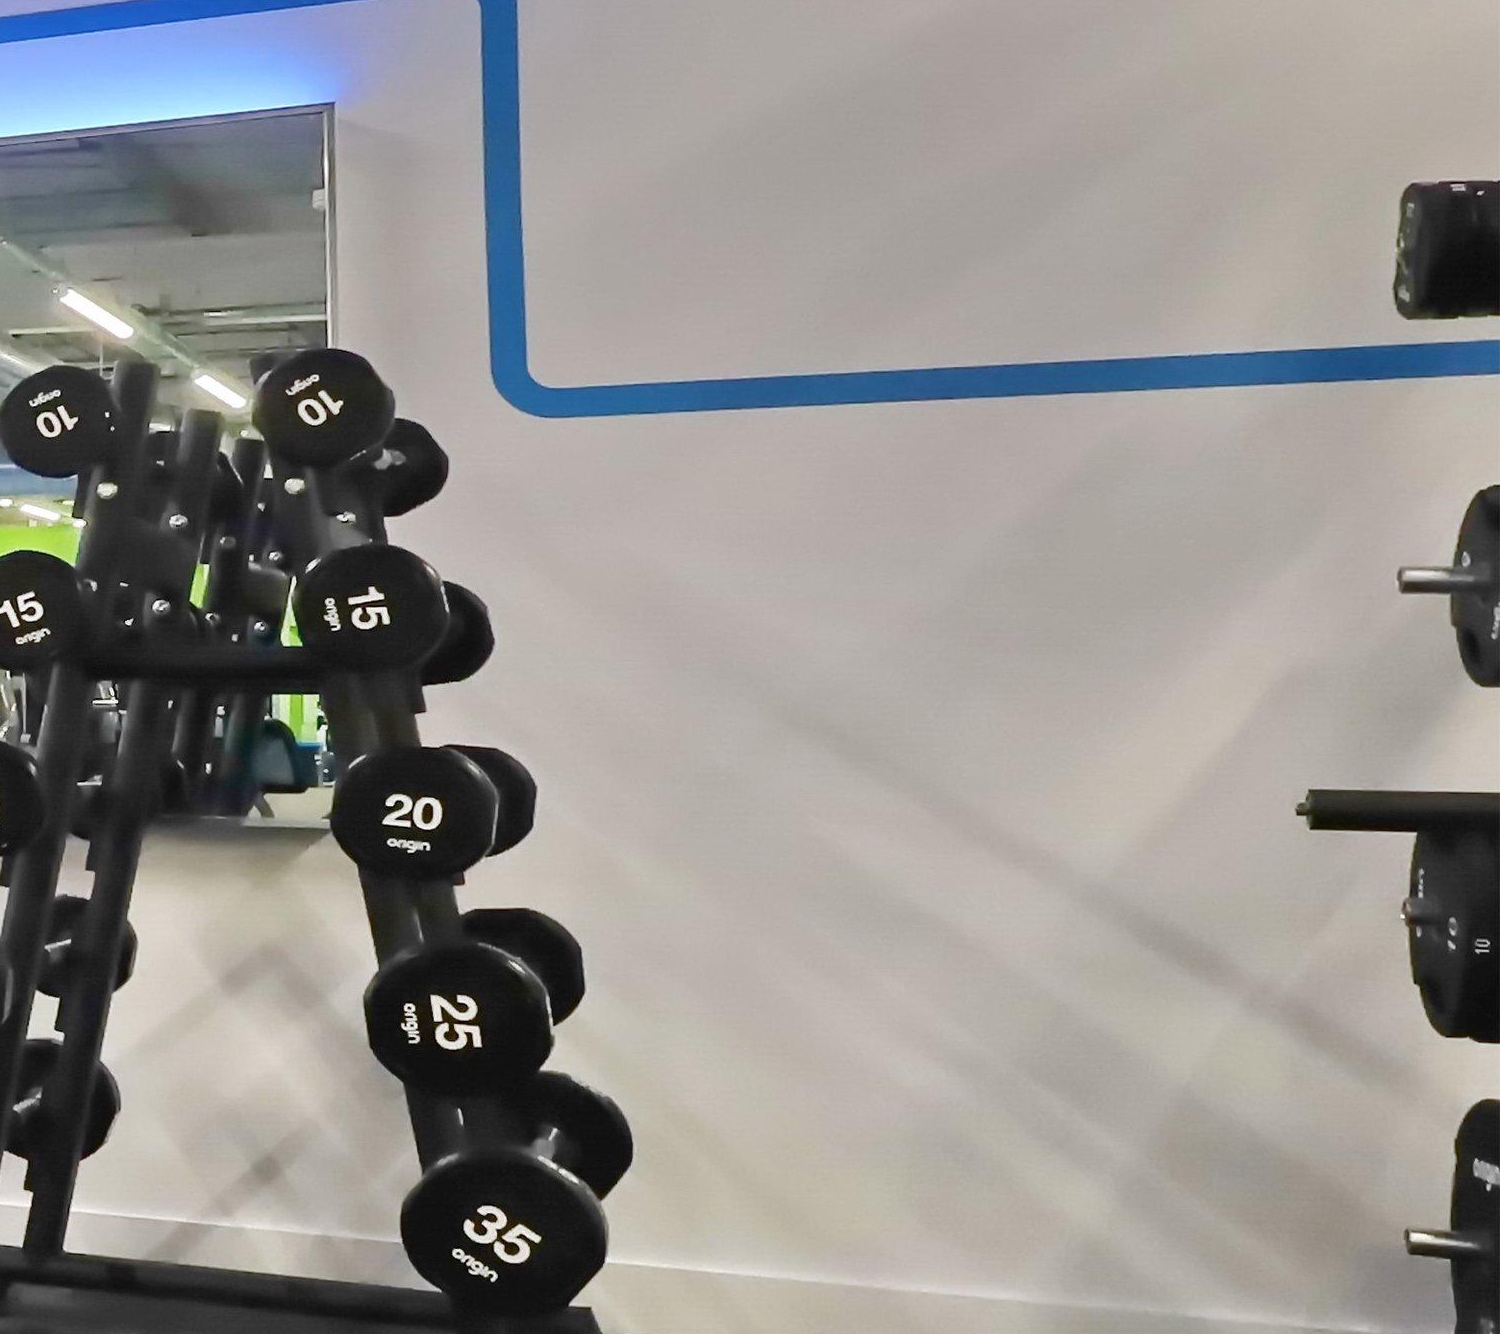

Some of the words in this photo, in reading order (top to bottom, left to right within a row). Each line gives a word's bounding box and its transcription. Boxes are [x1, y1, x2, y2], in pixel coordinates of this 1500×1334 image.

[286, 375, 319, 395] origin
[37, 405, 78, 437] 10
[298, 391, 343, 425] 10
[348, 587, 390, 629] 15
[16, 628, 51, 644] origin
[382, 794, 442, 830] 20
[387, 838, 430, 853] origin
[401, 1003, 420, 1043] origin
[430, 995, 482, 1050] 25
[464, 1206, 541, 1263] 35
[452, 1249, 498, 1282] origin
